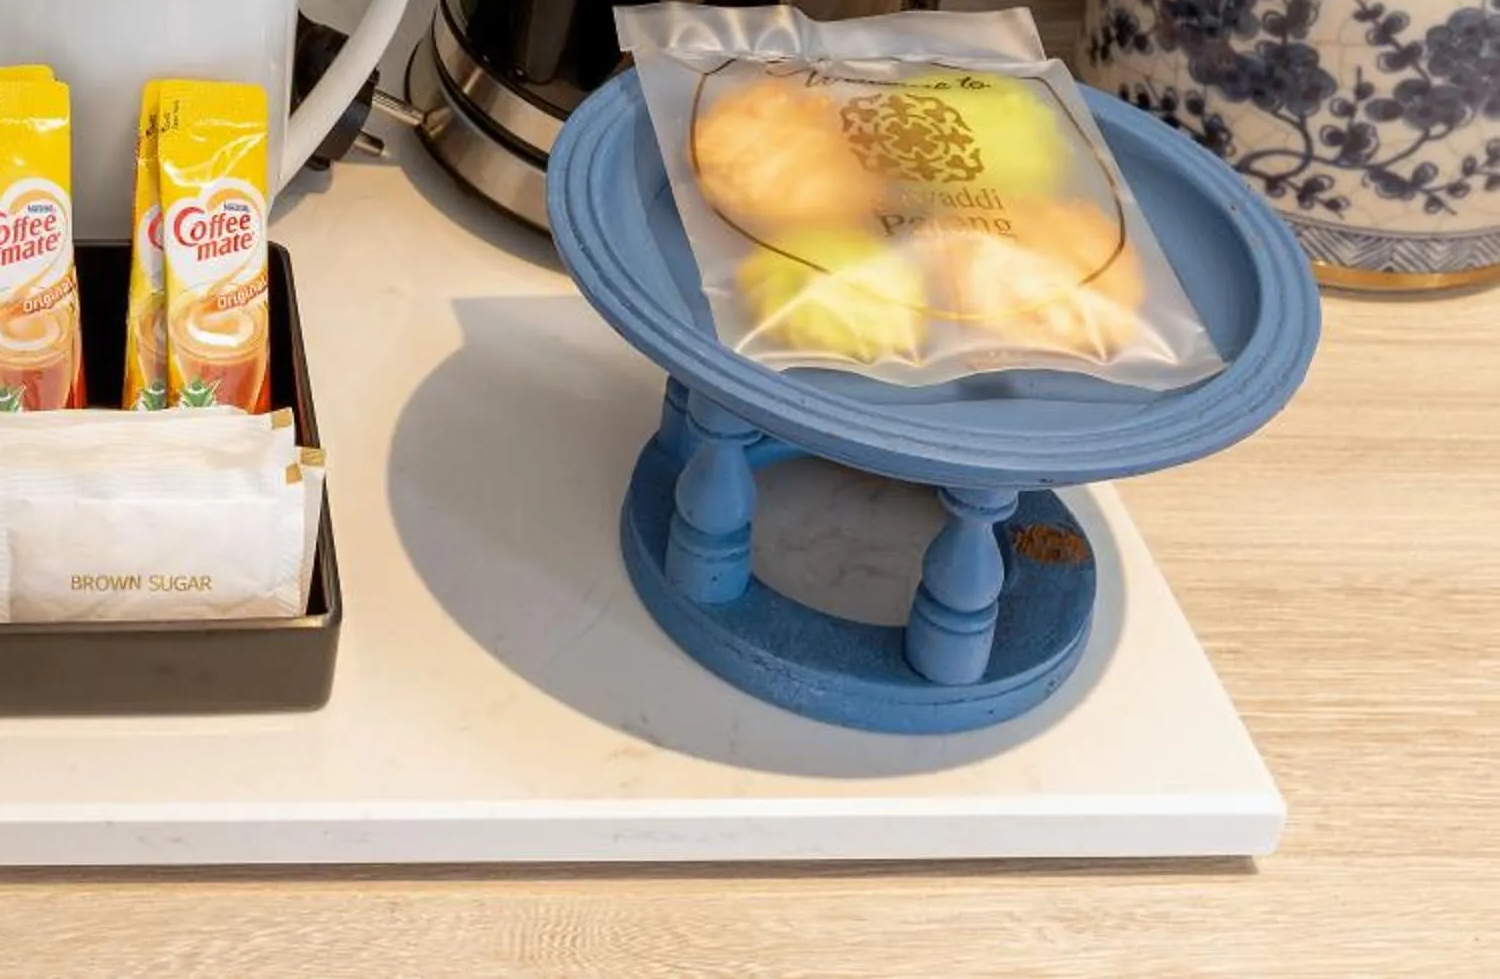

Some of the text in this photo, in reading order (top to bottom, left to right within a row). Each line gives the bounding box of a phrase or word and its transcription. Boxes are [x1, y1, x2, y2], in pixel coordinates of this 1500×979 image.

[876, 185, 1004, 211] addi
[174, 207, 250, 247] Coffee
[0, 232, 57, 266] mate
[197, 232, 253, 261] mate
[23, 276, 76, 312] Original
[71, 575, 212, 591] BROWN SUGAR
